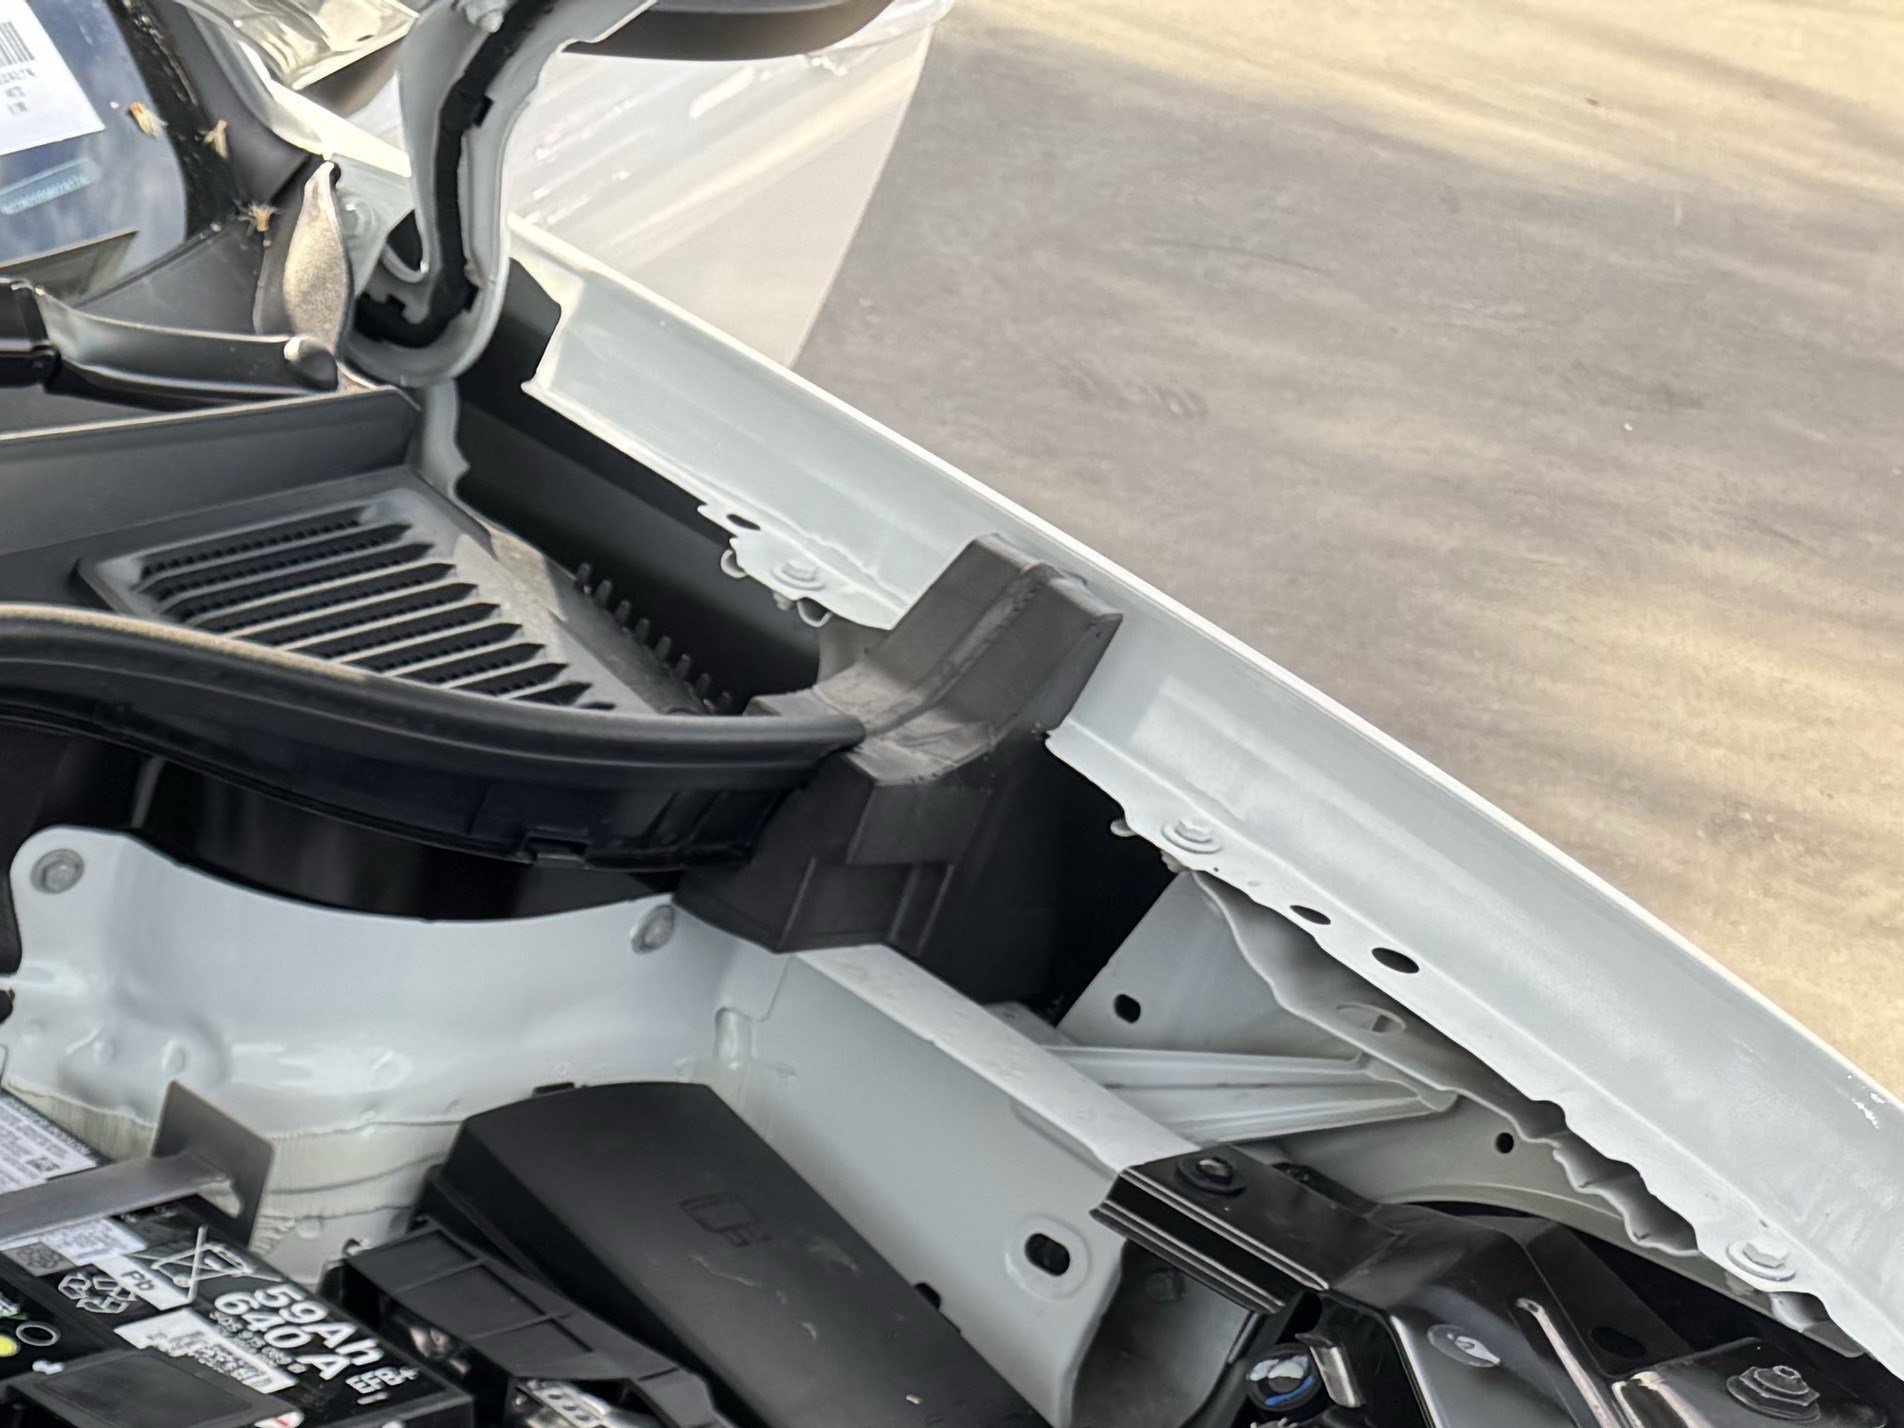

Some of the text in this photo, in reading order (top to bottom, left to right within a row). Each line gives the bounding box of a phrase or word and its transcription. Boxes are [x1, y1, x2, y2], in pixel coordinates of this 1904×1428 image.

[214, 1293, 305, 1350] 640
[297, 1353, 346, 1382] A
[254, 1286, 383, 1366] 59Ah
